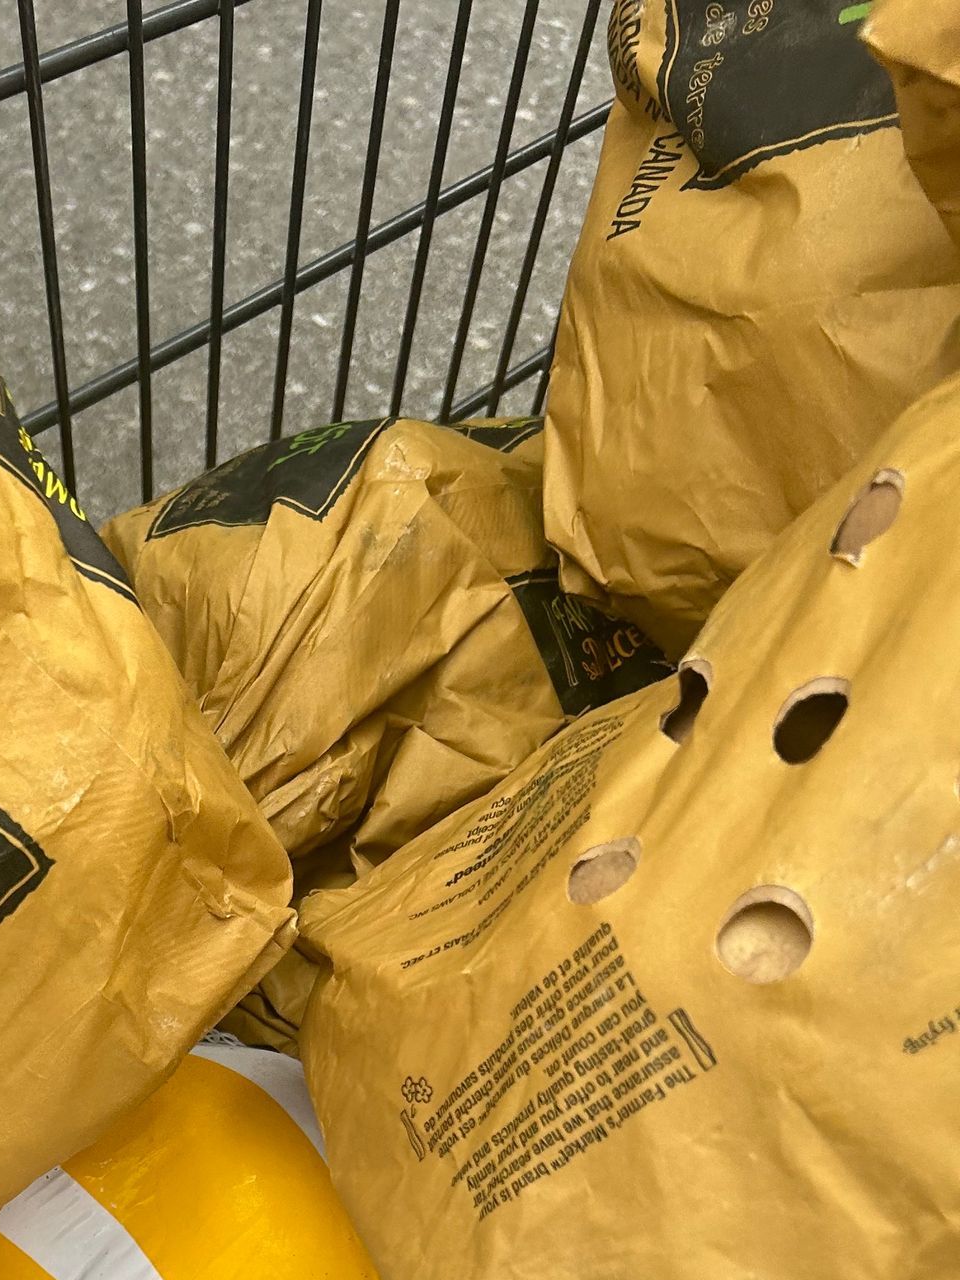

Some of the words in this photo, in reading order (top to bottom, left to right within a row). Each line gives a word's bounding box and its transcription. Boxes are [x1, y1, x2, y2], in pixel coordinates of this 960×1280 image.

[606, 132, 690, 241] CANADA
[573, 923, 611, 964] qualité
[591, 936, 618, 969] pour
[542, 969, 559, 990] de
[557, 958, 573, 977] et
[563, 965, 590, 993] vous
[614, 972, 635, 991] La
[510, 985, 543, 1020] valeur.
[536, 989, 562, 1019] offrir
[571, 986, 615, 1030] marque
[621, 989, 646, 1017] you
[515, 1014, 534, 1037] des
[596, 1012, 621, 1036] can
[531, 1025, 572, 1065] Délices
[561, 1032, 596, 1065] count
[573, 1008, 656, 1077] great-tasting
[639, 1028, 668, 1057] and
[514, 1059, 532, 1079] du
[612, 1048, 640, 1077] near
[612, 1046, 681, 1100] assurance
[664, 1065, 697, 1089] The
[537, 1071, 575, 1108] quality
[595, 1070, 613, 1088] to
[564, 1081, 596, 1110] offer
[584, 1095, 613, 1121] that
[606, 1083, 666, 1129] Farmer's
[491, 1099, 536, 1147] products
[539, 1100, 564, 1127] you
[563, 1114, 585, 1133] we
[518, 1121, 539, 1147] and
[531, 1128, 566, 1155] have
[511, 1162, 551, 1197] brand
[498, 1186, 513, 1203] is
